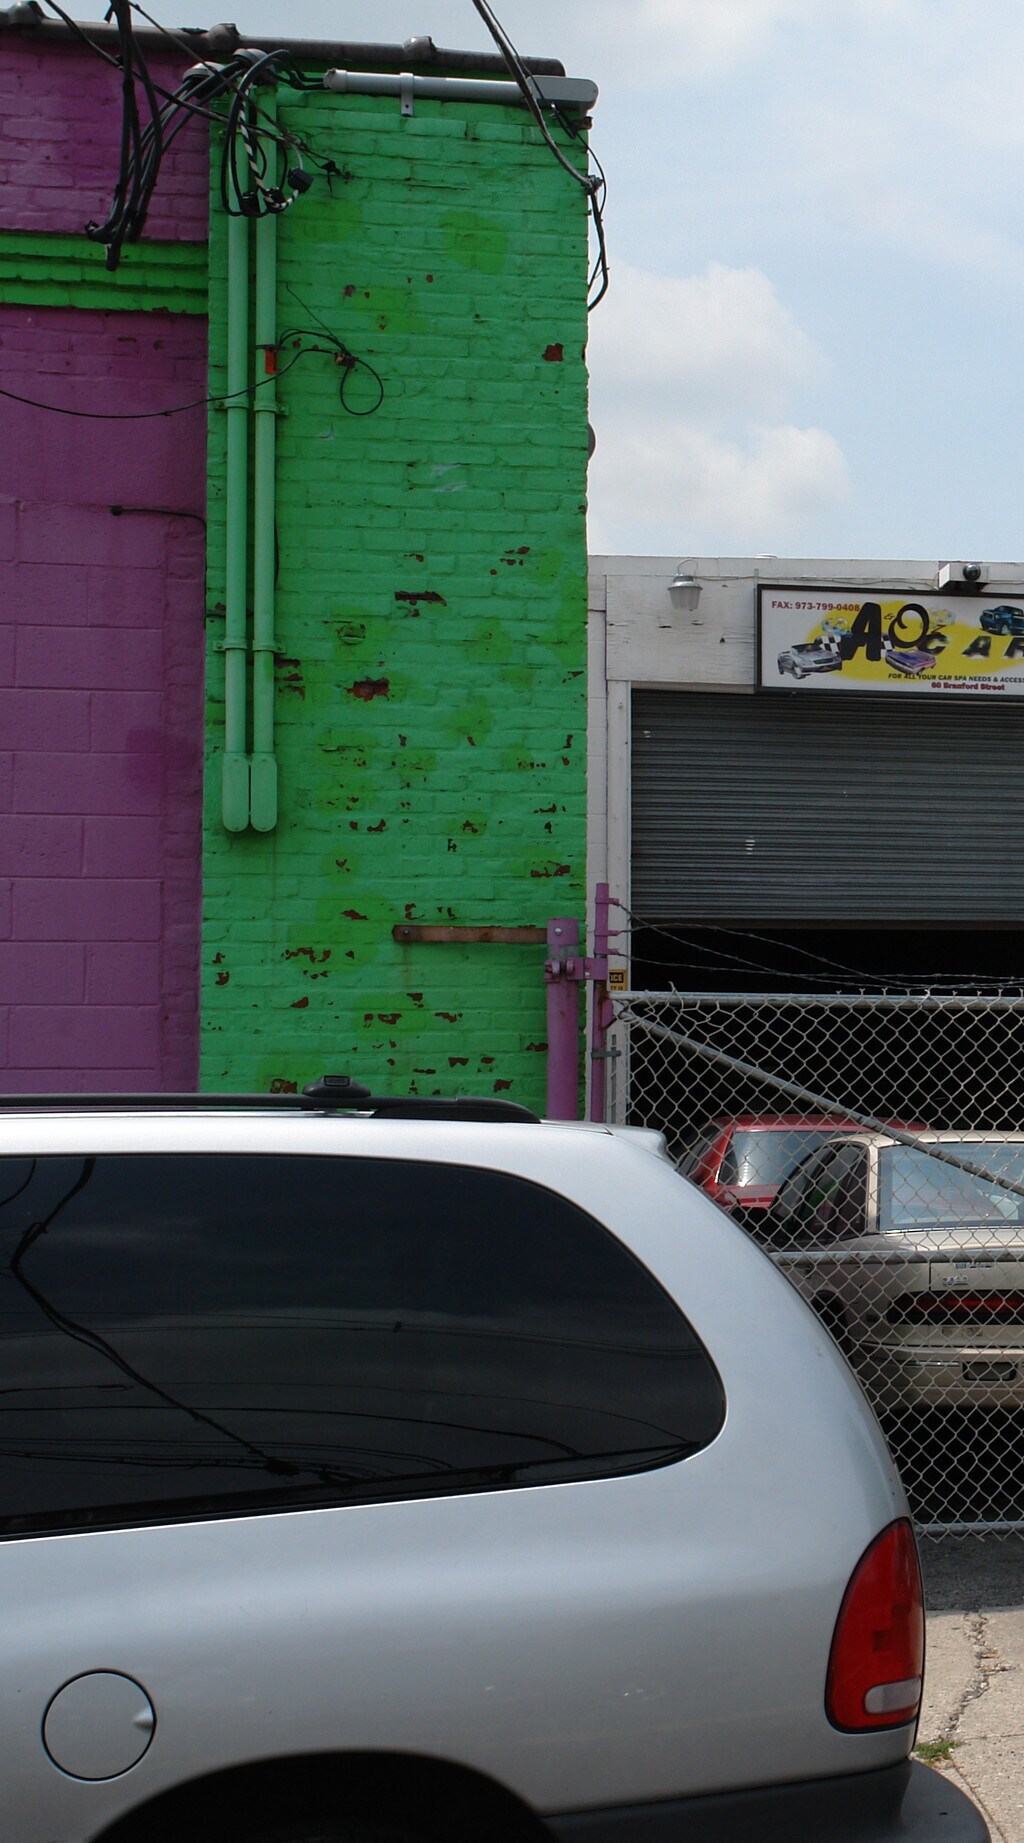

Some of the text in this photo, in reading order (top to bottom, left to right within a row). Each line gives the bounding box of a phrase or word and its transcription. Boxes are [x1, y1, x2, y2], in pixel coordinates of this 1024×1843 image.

[771, 601, 860, 612] FAX: 973-799-0408
[980, 683, 1005, 691] Street
